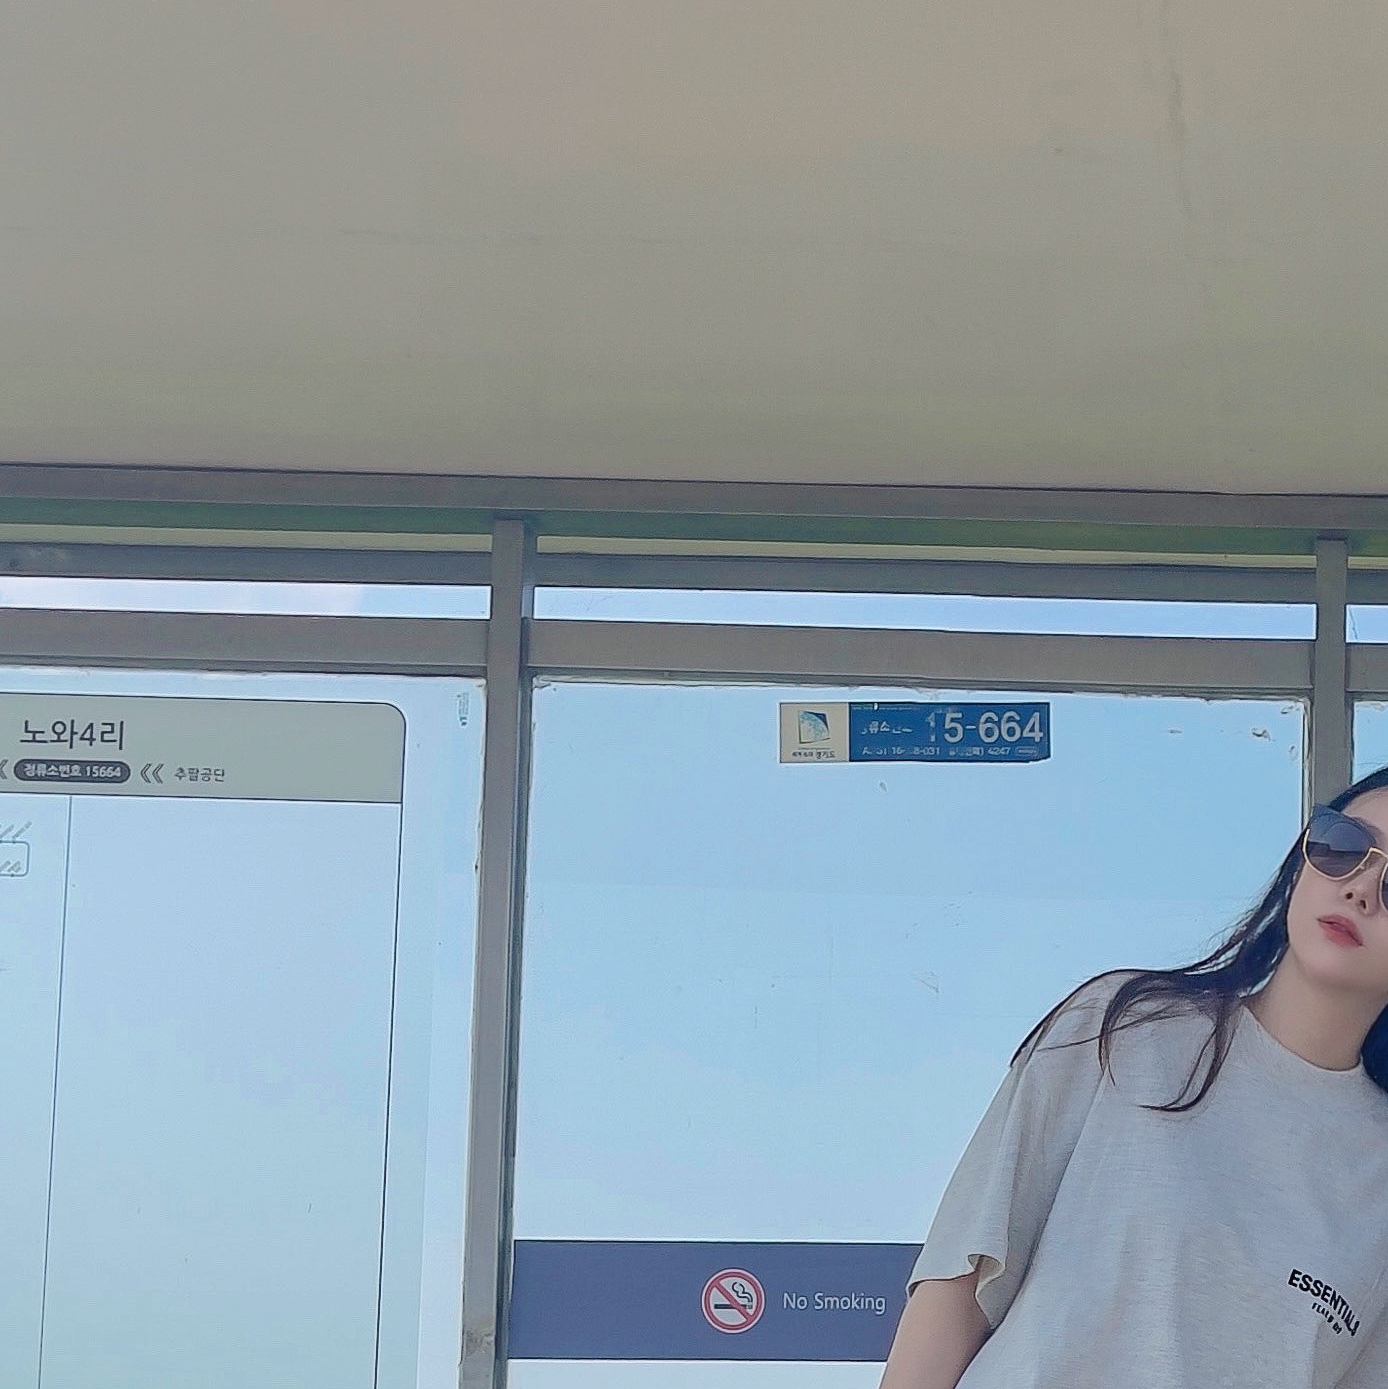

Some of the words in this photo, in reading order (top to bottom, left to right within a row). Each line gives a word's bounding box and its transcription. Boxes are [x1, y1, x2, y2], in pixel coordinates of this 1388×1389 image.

[20, 719, 124, 750] 노와4리
[925, 710, 1044, 743] 15-664
[24, 763, 83, 778] 정류소번호
[85, 766, 121, 779] 15664
[783, 1292, 808, 1310] No
[814, 1292, 886, 1315] Smoking
